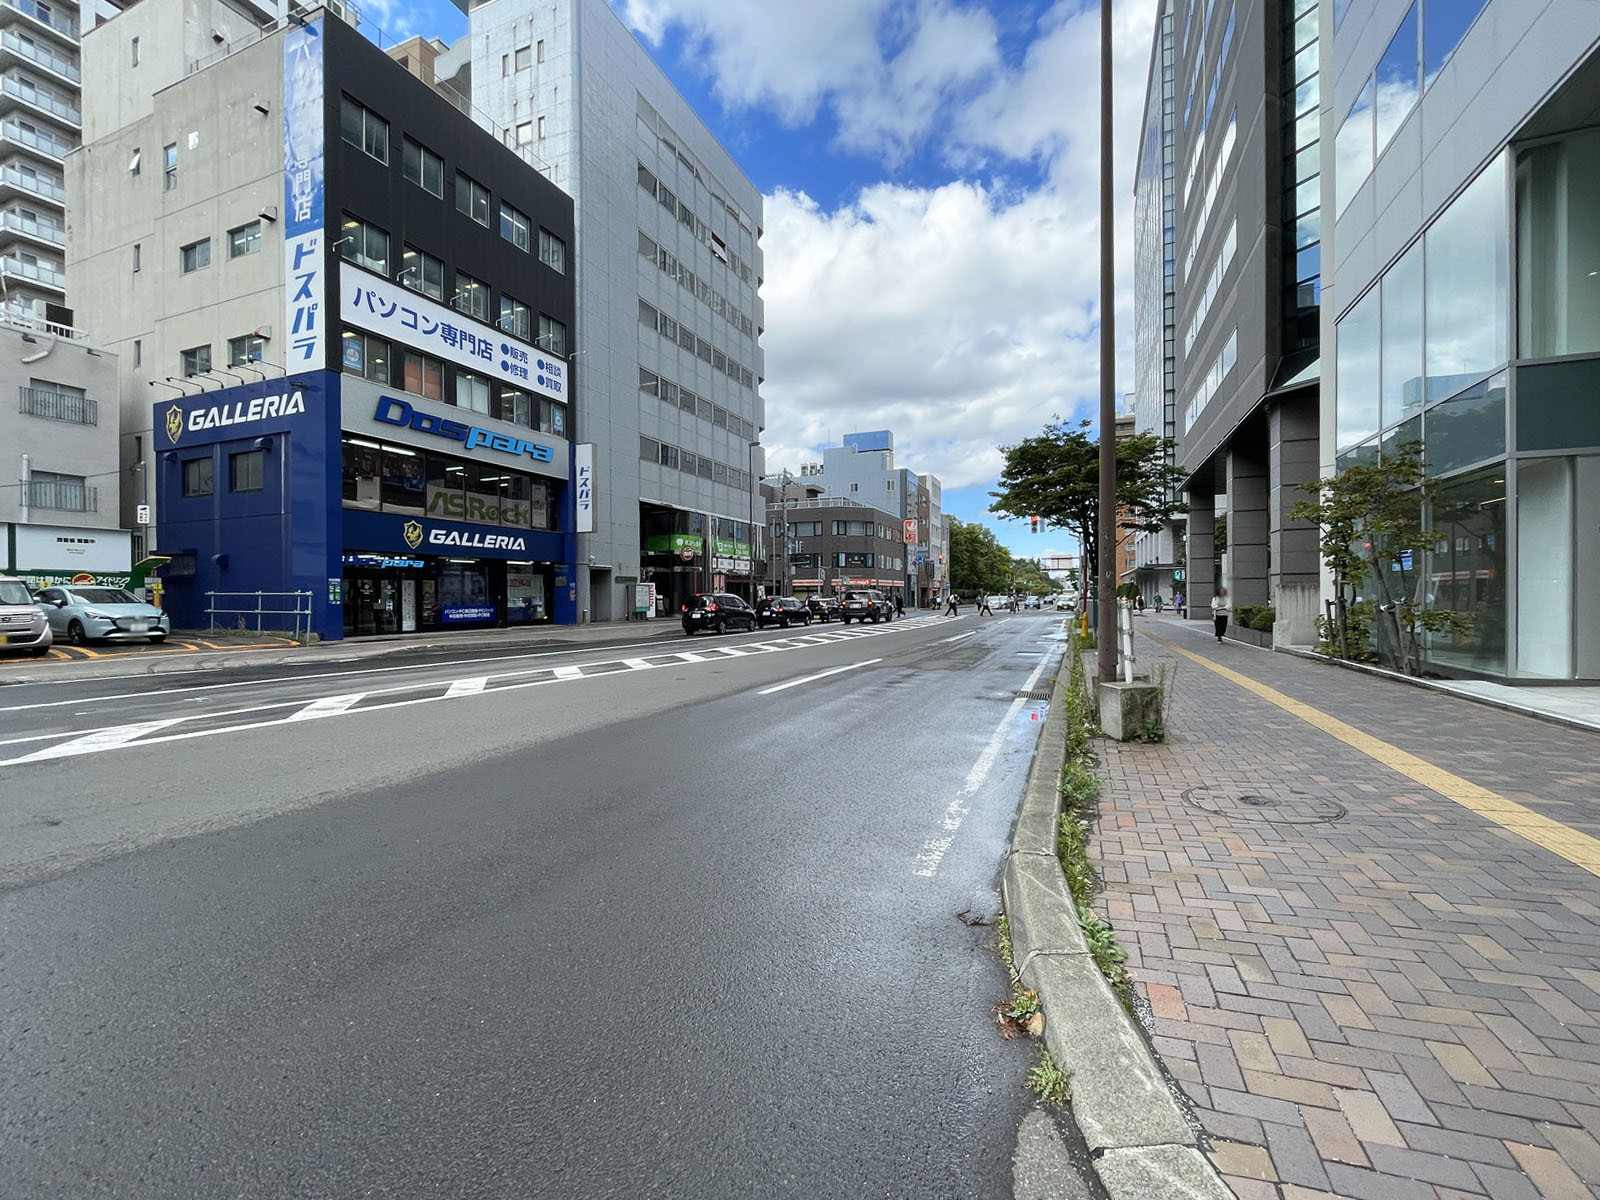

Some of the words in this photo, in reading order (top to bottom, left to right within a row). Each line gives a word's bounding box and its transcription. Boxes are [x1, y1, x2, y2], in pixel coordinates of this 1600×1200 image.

[291, 238, 318, 360] ドスパラ
[353, 287, 494, 362] パソコン専門店
[509, 363, 529, 381] 修理
[188, 391, 305, 432] GALLERIA
[373, 395, 555, 463] Dospara
[428, 491, 529, 525] ASRock
[579, 466, 591, 510] ドスパラ
[429, 529, 526, 551] GALLERIA
